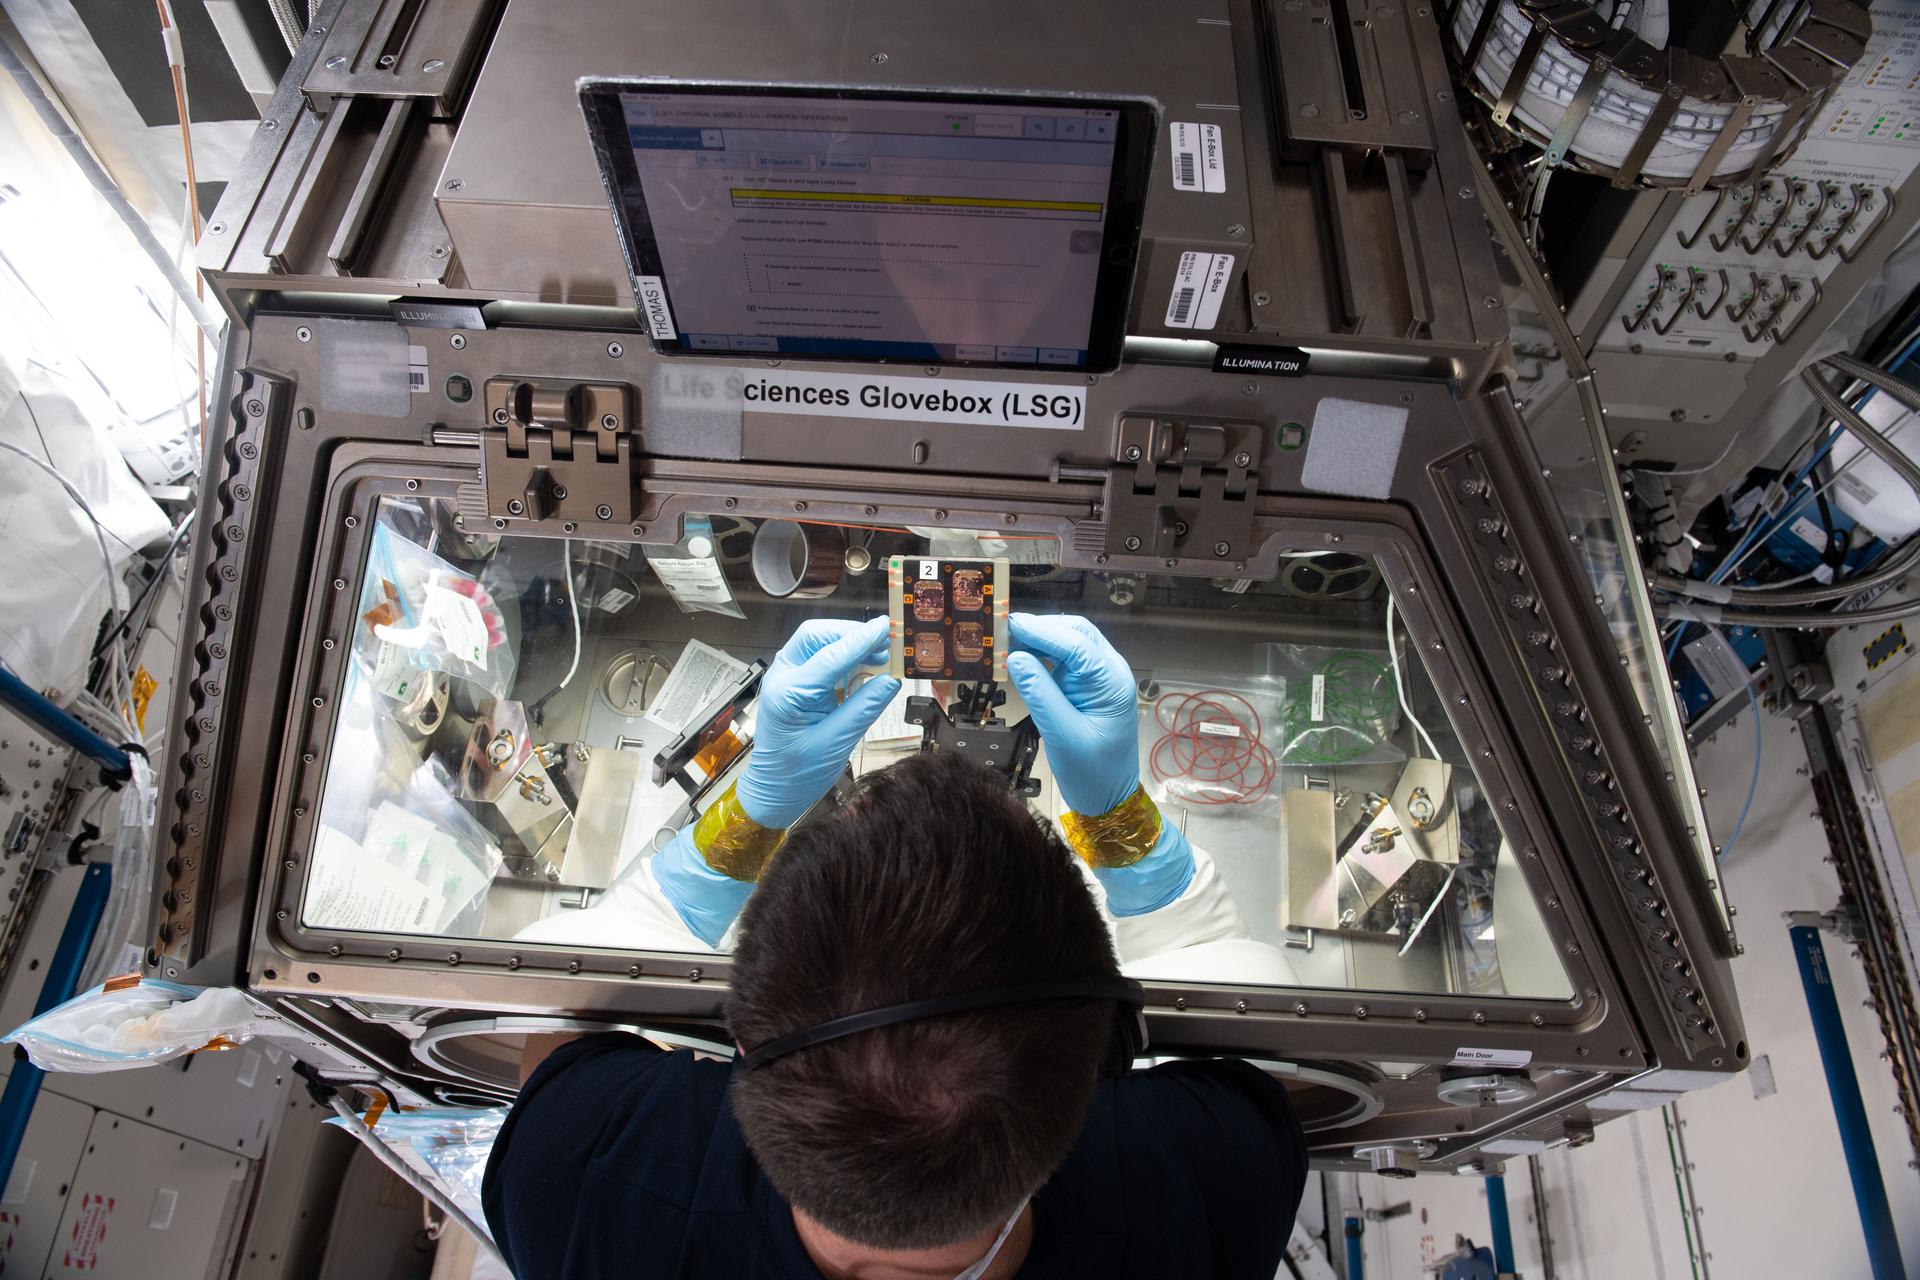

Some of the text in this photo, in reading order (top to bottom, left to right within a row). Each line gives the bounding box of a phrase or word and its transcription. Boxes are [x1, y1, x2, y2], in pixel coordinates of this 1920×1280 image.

[1211, 256, 1229, 292] Fan E-Box
[646, 290, 670, 336] THOMAS
[1222, 358, 1299, 371] ILLUMINATION
[726, 375, 850, 406] Sciences
[859, 384, 993, 415] Glovebox
[1001, 392, 1082, 425] (LSG)
[925, 566, 932, 576] 2
